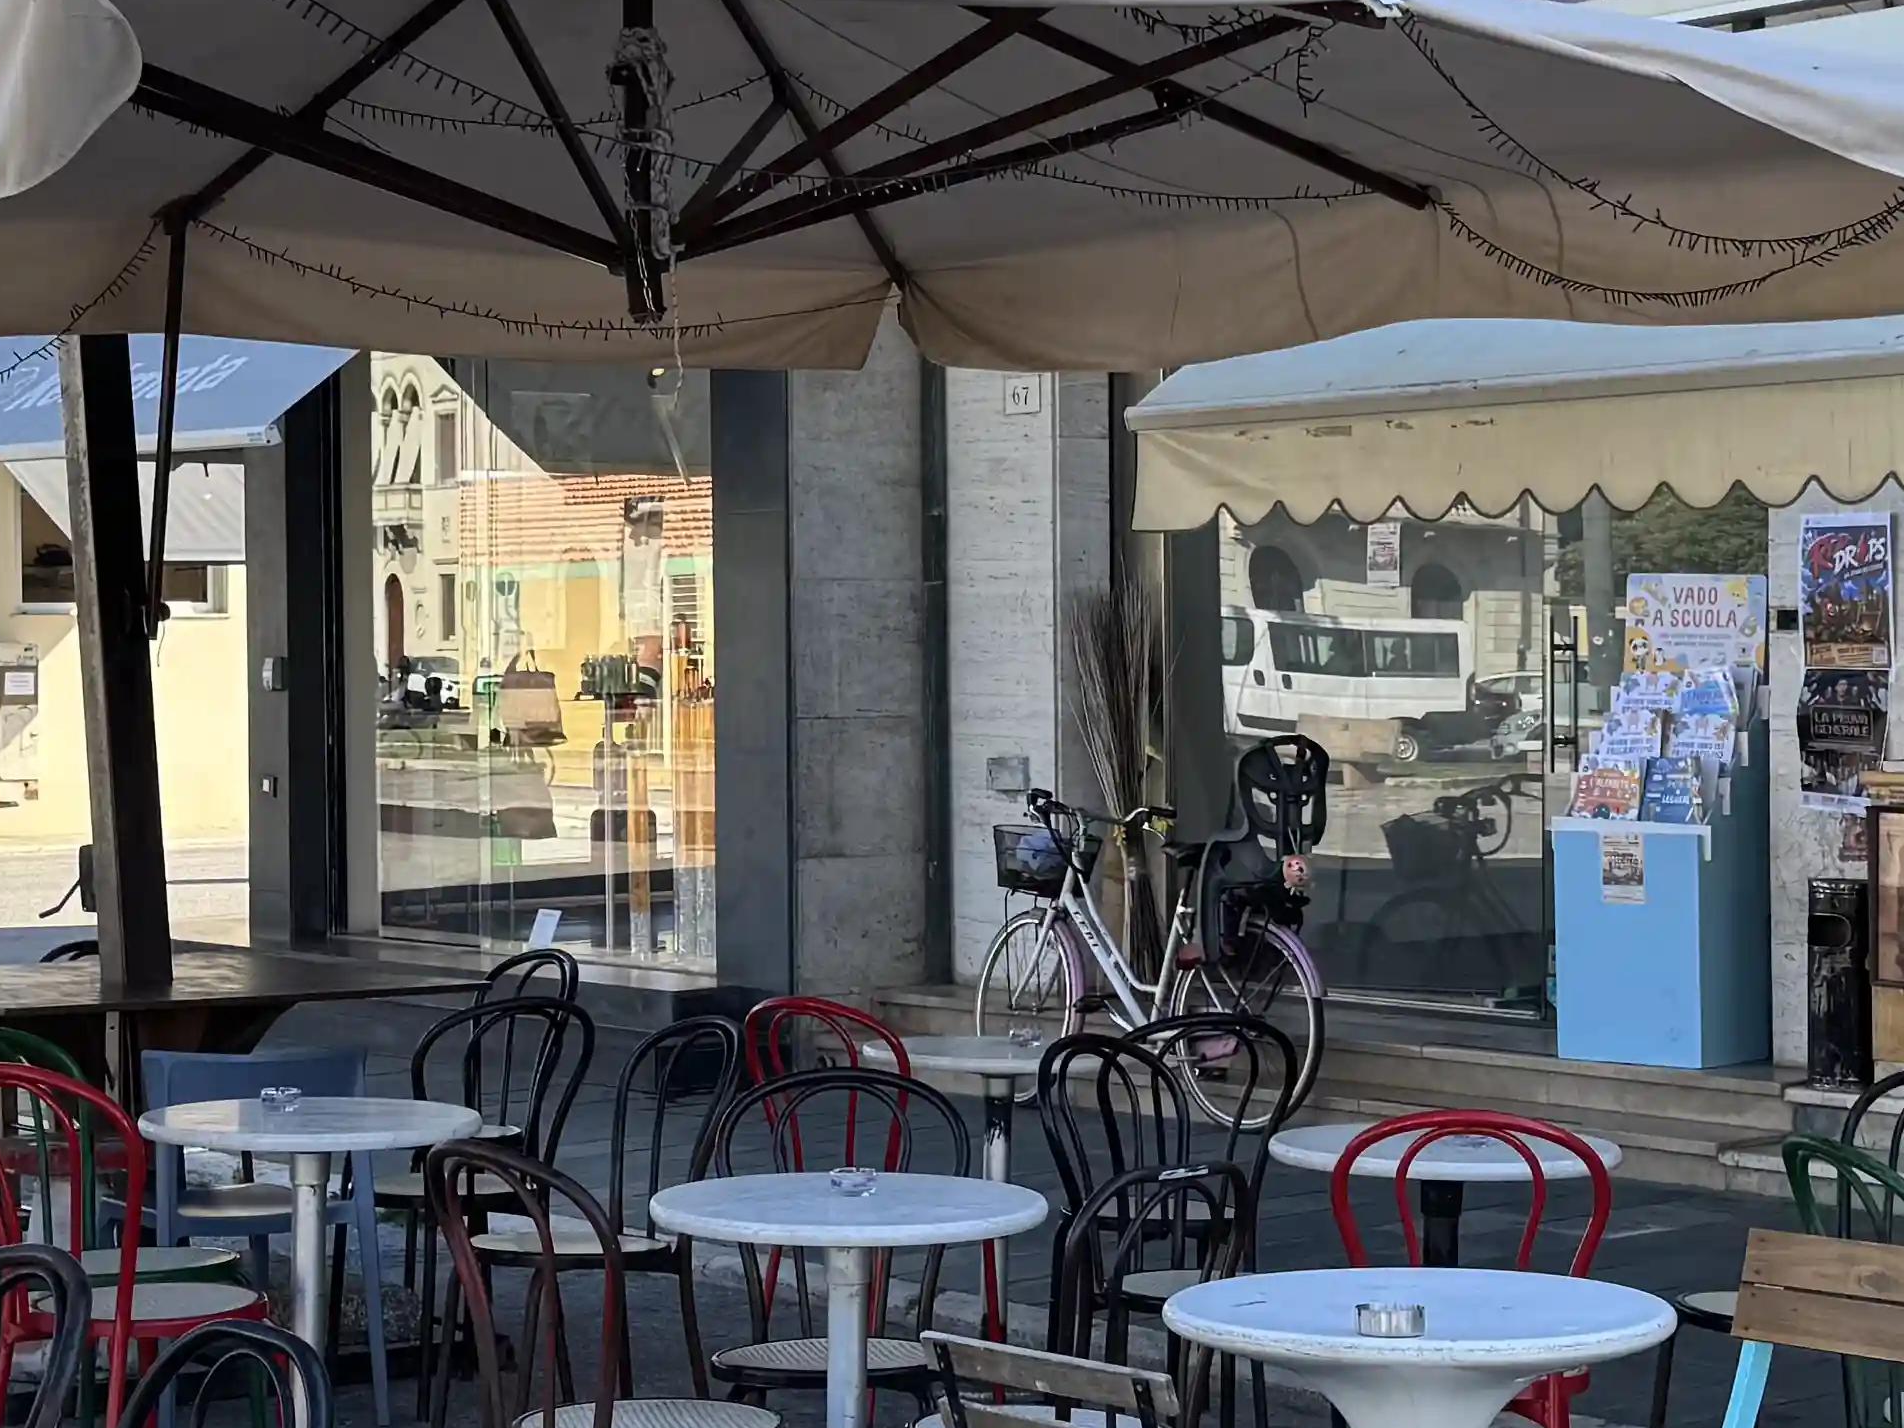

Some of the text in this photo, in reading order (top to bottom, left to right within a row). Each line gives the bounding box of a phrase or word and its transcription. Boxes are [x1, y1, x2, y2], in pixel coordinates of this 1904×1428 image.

[1012, 386, 1030, 406] 67
[1672, 585, 1719, 606] VADO
[1651, 608, 1738, 628] A SCUOLA
